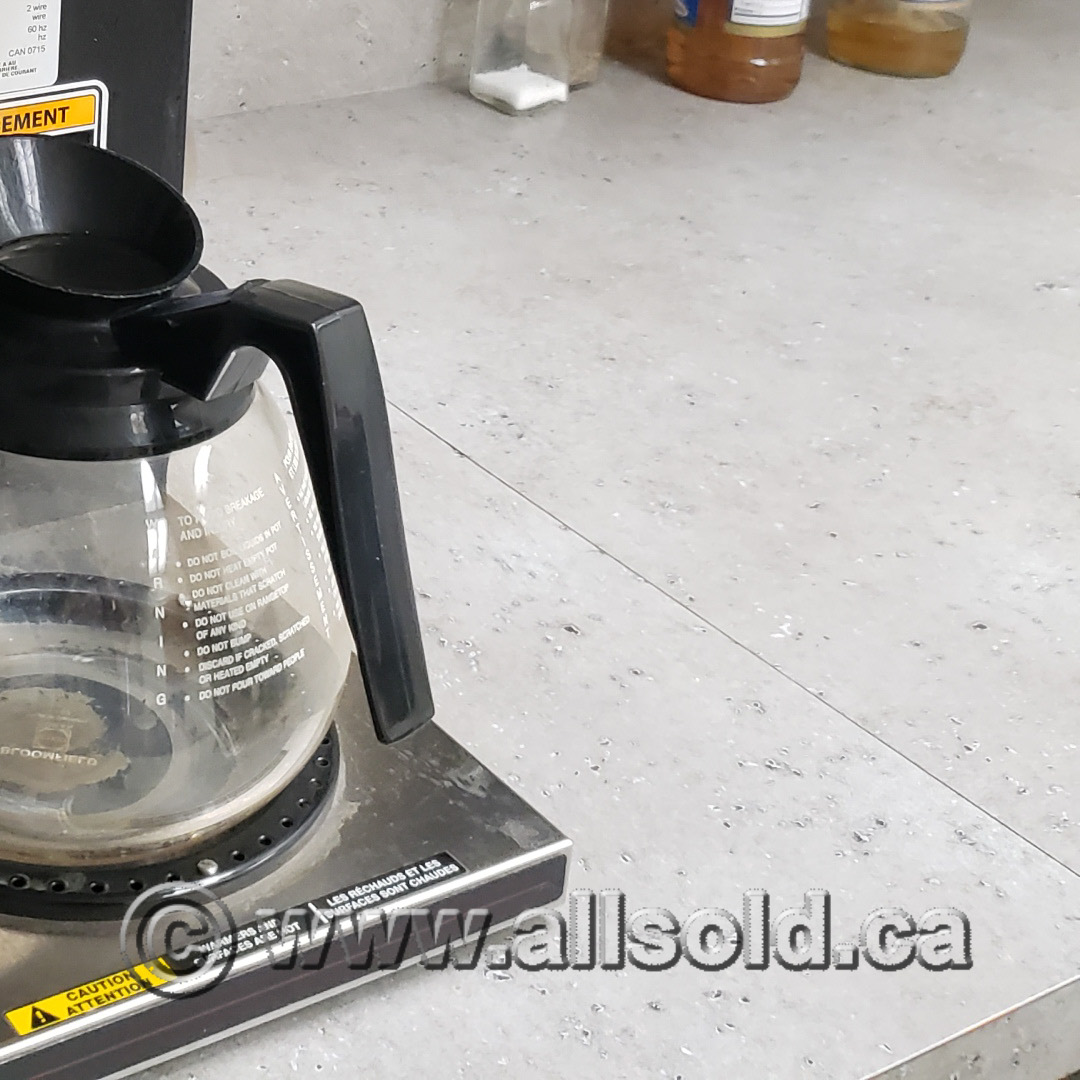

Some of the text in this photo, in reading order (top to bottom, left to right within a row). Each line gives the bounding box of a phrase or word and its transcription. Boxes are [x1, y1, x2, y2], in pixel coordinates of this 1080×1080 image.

[31, 13, 47, 21] wire
[32, 3, 47, 12] wire
[27, 24, 47, 33] 60 hz
[37, 33, 47, 41] hz
[8, 44, 46, 57] CAN 0715
[177, 514, 192, 527] TO
[180, 527, 202, 542] AND
[187, 554, 201, 567] DO
[202, 552, 219, 564] NOT
[270, 520, 282, 535] POT
[189, 571, 203, 584] DO
[204, 567, 221, 581] NOT
[265, 542, 278, 557] POT
[191, 587, 205, 599] DO
[206, 583, 223, 595] NOT
[225, 575, 250, 591] CLEAN
[193, 568, 286, 611] MATERIALS THAT SCRATCH
[194, 583, 289, 628] DO NOT USE ON RANGETOP
[196, 618, 247, 641] OF ANY KIND
[196, 632, 252, 657] DO NOT BUMP
[198, 654, 234, 673] DISCARD
[235, 652, 243, 663] IF
[278, 615, 311, 643] SCRATCHED
[198, 653, 270, 685] OR HEATED EMPTY
[198, 647, 306, 701] DO NOT POUR TOWARD PEOPLE
[325, 863, 459, 919] SURFACES SONT CHAUDES
[326, 859, 442, 907] LES RÉCHAUDS ET LES
[67, 978, 152, 1016] ATTENTION
